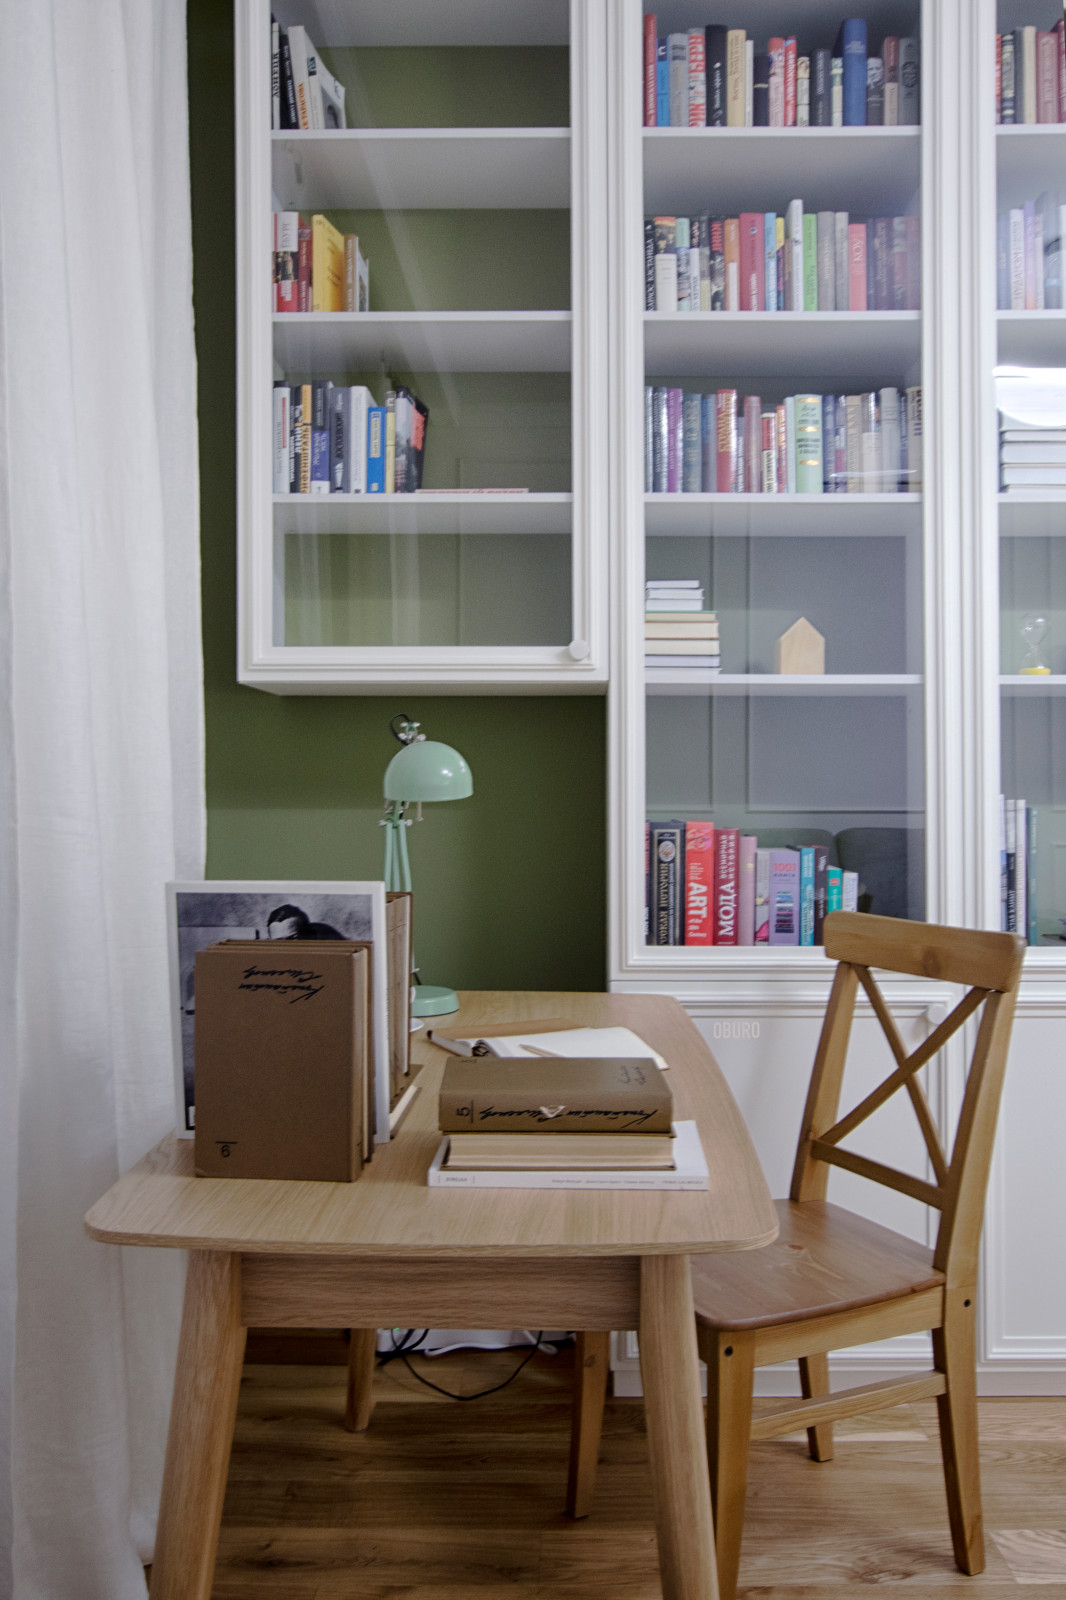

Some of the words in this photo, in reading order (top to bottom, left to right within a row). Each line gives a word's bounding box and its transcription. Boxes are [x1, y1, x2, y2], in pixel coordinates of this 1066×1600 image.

[719, 835, 727, 879] ВСЕМИРНАЯ
[727, 835, 735, 879] ИСТОРИЯ
[773, 863, 796, 872] 1001
[688, 882, 707, 918] ART
[718, 881, 737, 936] МОДА
[456, 1106, 471, 1117] 5
